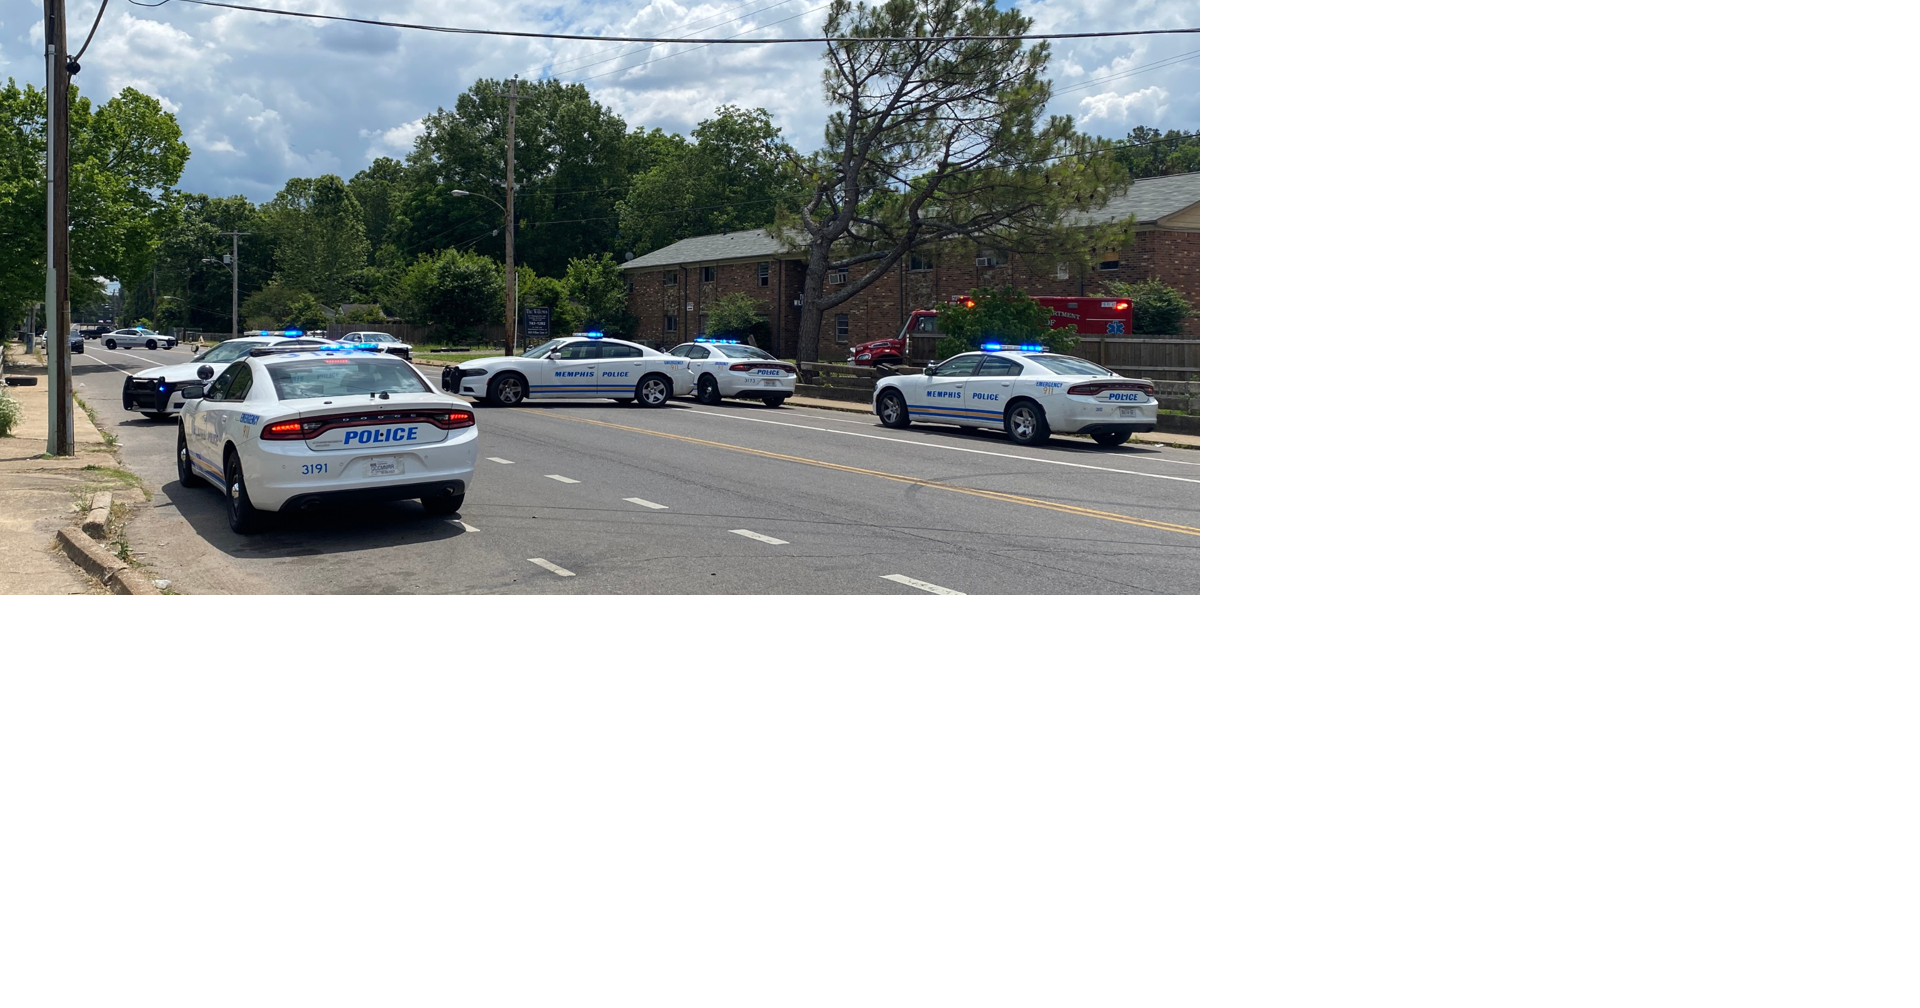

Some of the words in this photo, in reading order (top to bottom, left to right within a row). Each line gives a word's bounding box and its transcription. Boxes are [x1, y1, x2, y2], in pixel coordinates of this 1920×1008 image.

[926, 390, 962, 399] MEMPHIS
[972, 392, 1000, 401] POLICE
[1043, 387, 1053, 395] 911
[1108, 393, 1138, 401] POLICE
[240, 412, 260, 425] EMERGENCY
[344, 426, 419, 445] POLICE
[302, 463, 328, 475] 3191
